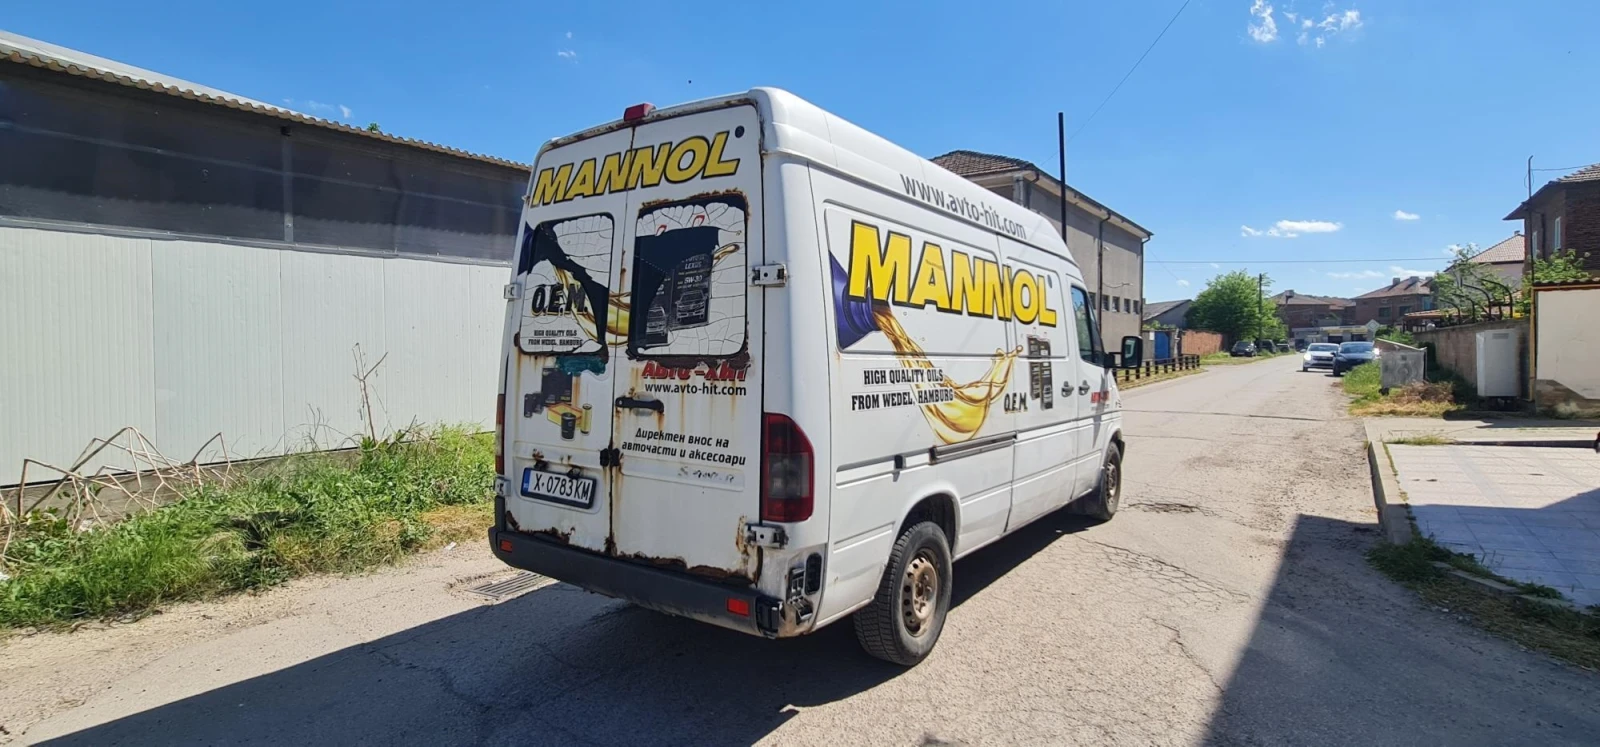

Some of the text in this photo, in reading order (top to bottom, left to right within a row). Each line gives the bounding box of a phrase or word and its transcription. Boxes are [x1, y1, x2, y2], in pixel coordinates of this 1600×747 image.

[531, 131, 740, 207] MANNOL
[900, 173, 1027, 240] www.avto-hit.com
[849, 219, 1057, 327] MANNOL
[531, 283, 588, 316] O.E.M.
[645, 382, 747, 396] www.avto-hit.com
[863, 368, 944, 385] HIGH QUALITY OILS
[851, 394, 880, 411] FROM
[917, 388, 954, 404] HAMBURG
[635, 427, 730, 448] Директен внос на
[622, 441, 746, 466] авточасти и аксесоари
